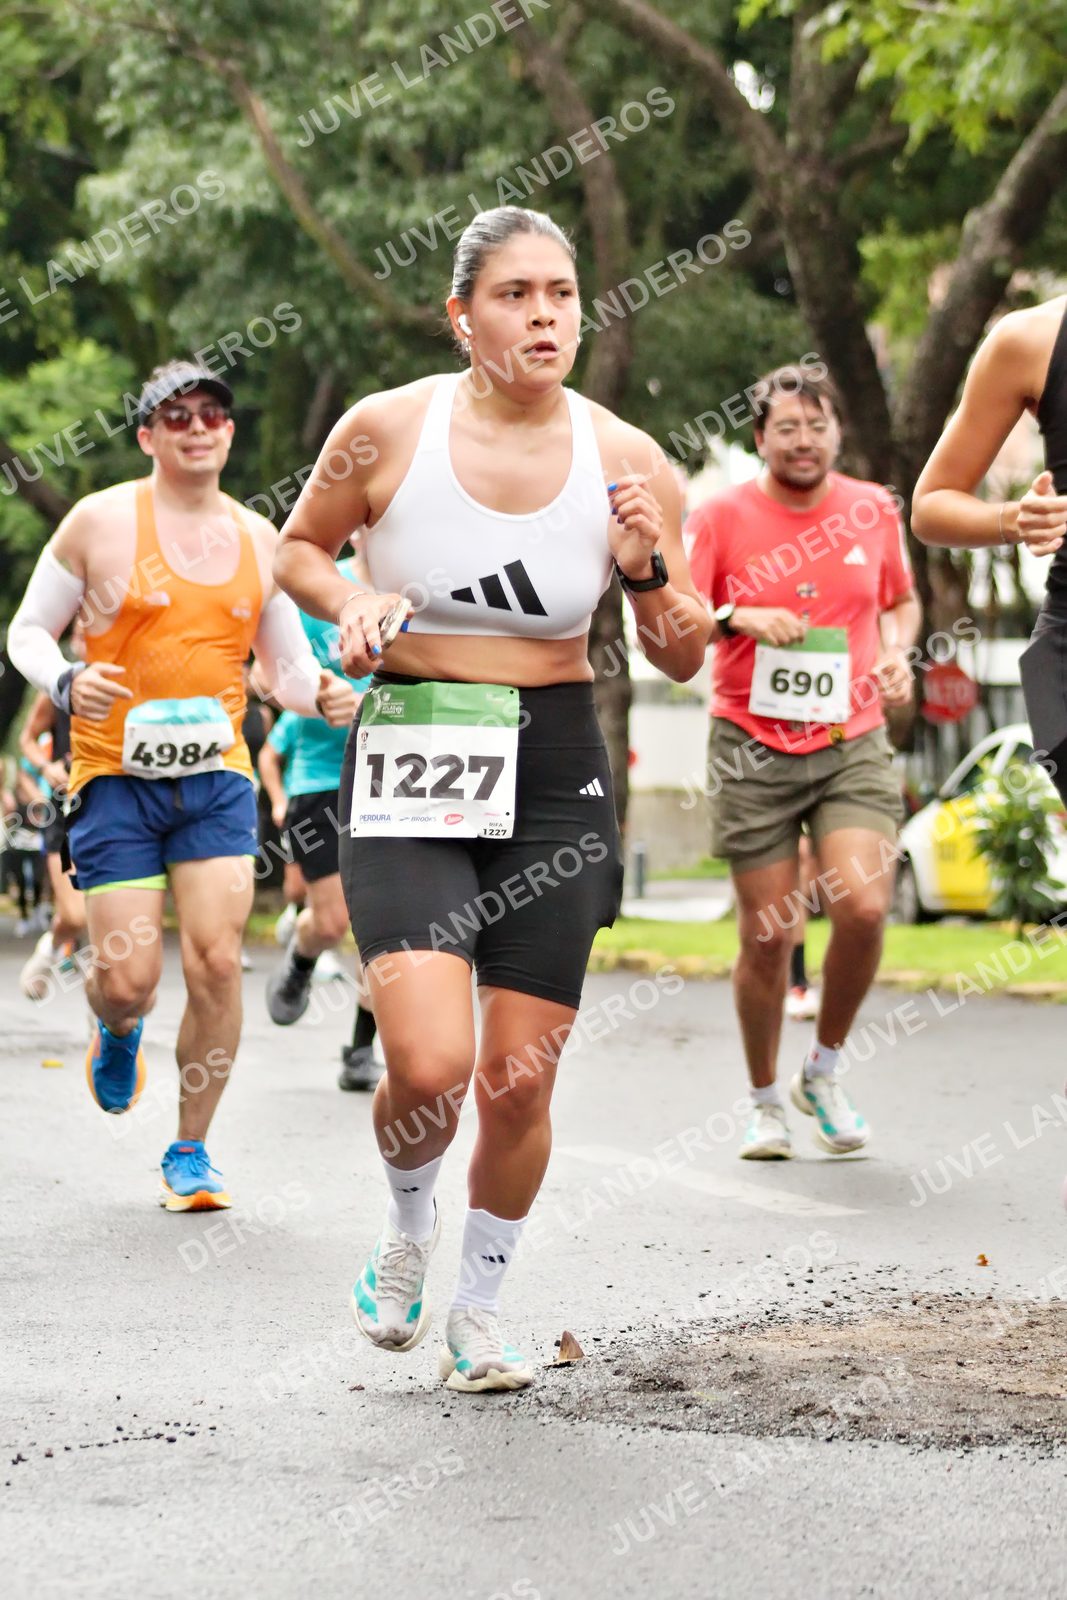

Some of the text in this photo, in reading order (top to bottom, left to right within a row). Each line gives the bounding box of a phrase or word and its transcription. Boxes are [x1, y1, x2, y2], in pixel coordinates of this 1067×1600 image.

[770, 668, 834, 697] 690
[366, 752, 505, 801] 1227
[359, 814, 392, 822] PERDURA
[410, 815, 437, 823] BROOKS
[483, 828, 508, 837] 1227
